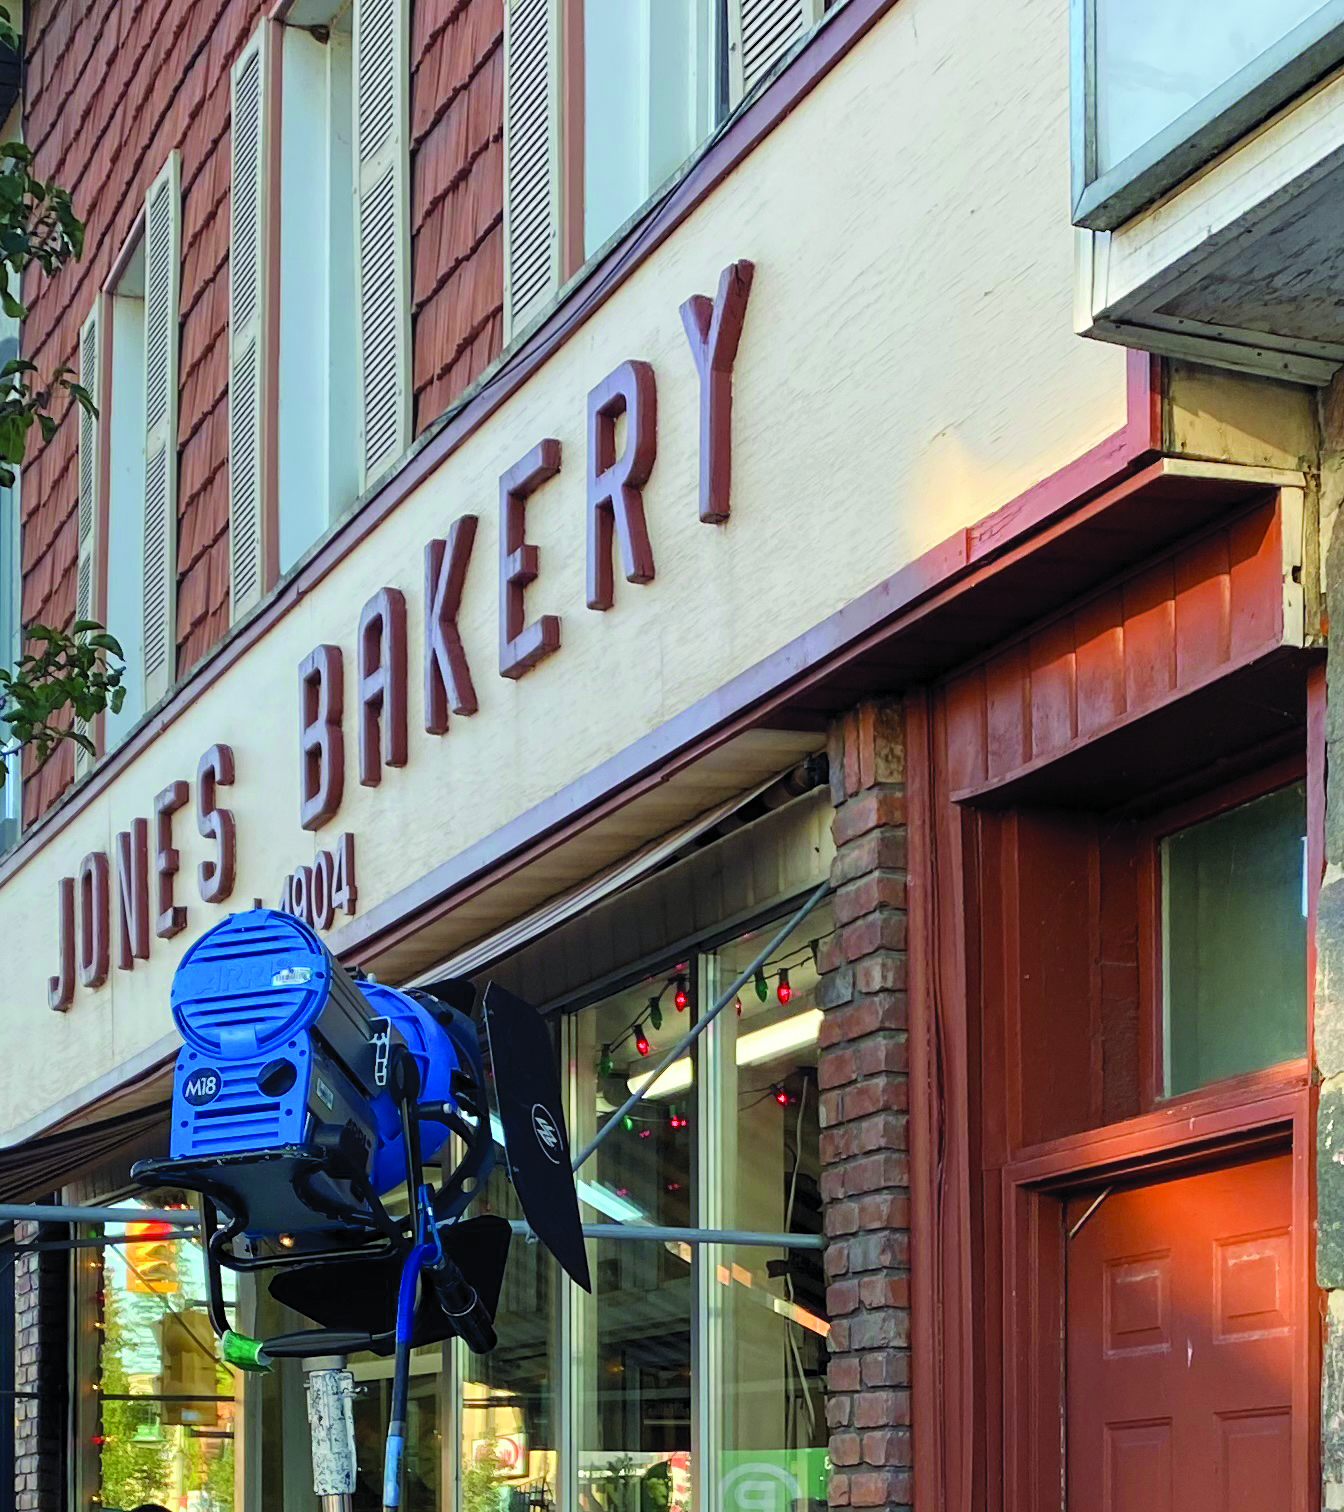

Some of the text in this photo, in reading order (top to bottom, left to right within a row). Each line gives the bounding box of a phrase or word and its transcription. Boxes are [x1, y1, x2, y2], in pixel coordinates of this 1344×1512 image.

[47, 258, 755, 1013] JONES BAKERY
[184, 1076, 217, 1098] M18
